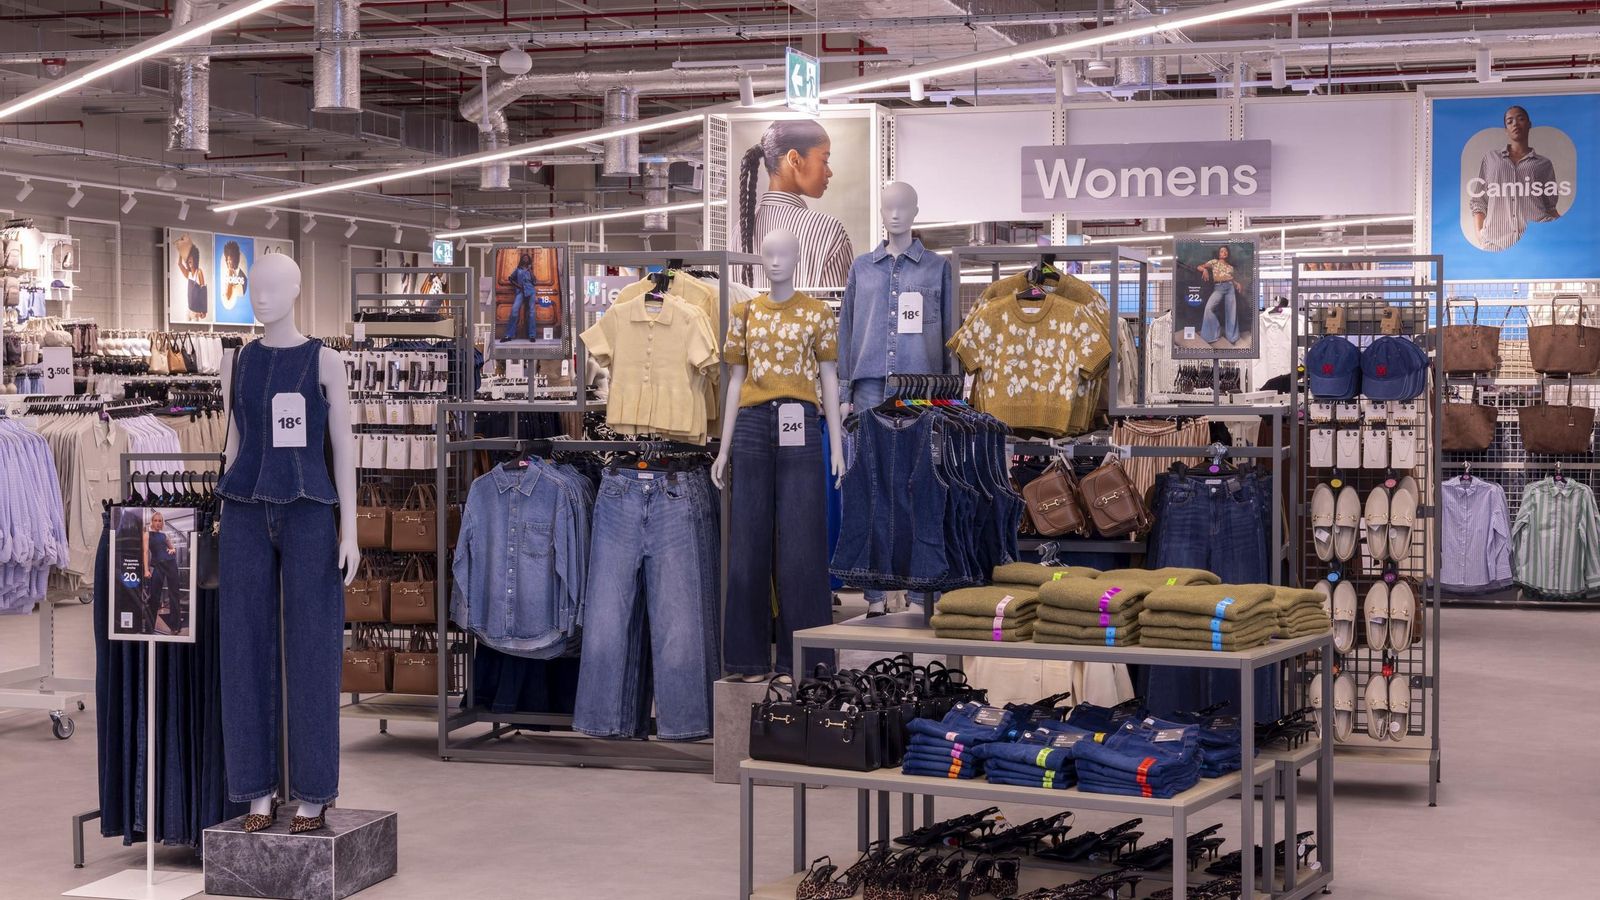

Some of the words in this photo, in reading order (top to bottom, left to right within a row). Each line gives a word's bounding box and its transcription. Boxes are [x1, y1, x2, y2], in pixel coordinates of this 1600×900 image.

[1034, 156, 1259, 200] Womens
[1466, 175, 1572, 198] Camisas
[902, 310, 920, 320] 18€
[47, 366, 71, 380] 3.50€
[278, 417, 302, 429] 18€
[782, 422, 803, 433] 24€
